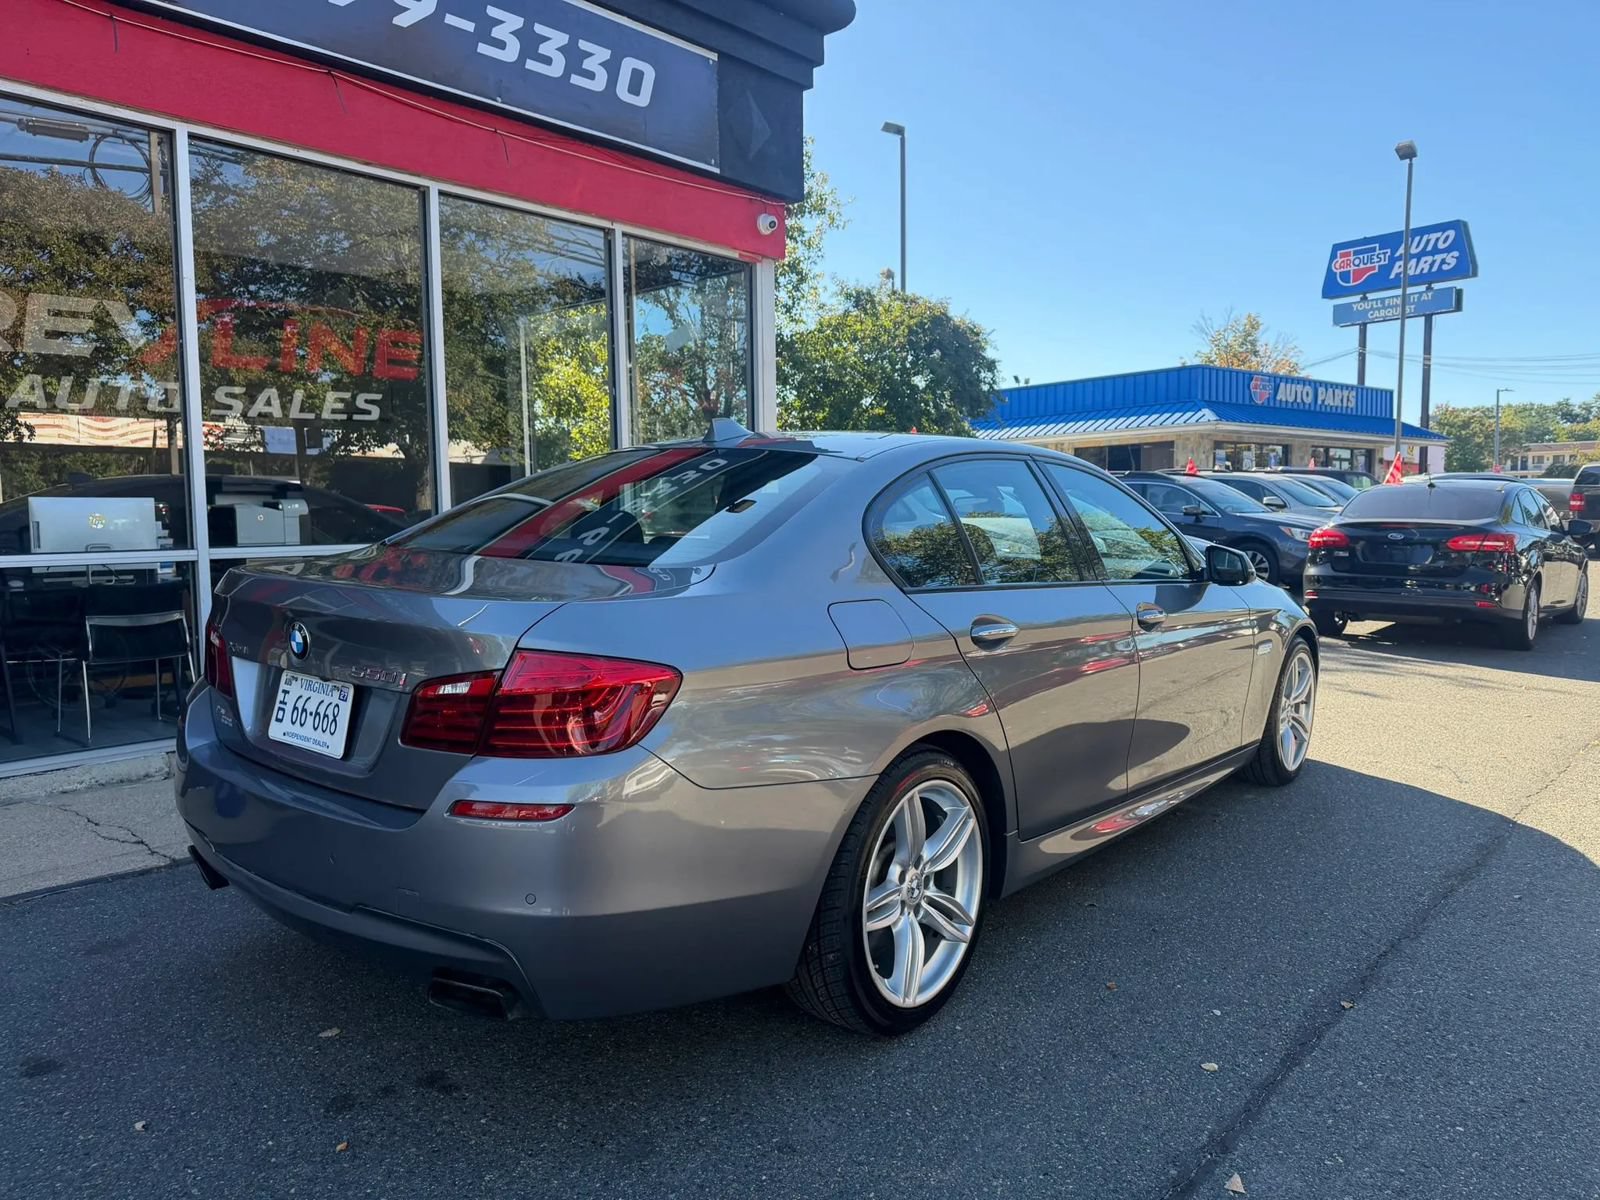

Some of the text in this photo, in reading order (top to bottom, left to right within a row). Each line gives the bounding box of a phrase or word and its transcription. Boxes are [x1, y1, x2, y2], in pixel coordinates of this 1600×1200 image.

[1394, 229, 1456, 257] AUTO
[1334, 251, 1389, 270] CARQUEST
[1389, 251, 1460, 279] PARTS
[1410, 294, 1419, 303] IT
[1368, 304, 1416, 319] CARQUST
[4, 373, 384, 422] AUTO SALES
[1276, 382, 1357, 408] AUTO PARTS
[300, 677, 335, 697] VIRGINIA
[340, 691, 348, 700] 27
[290, 694, 340, 736] 66-668
